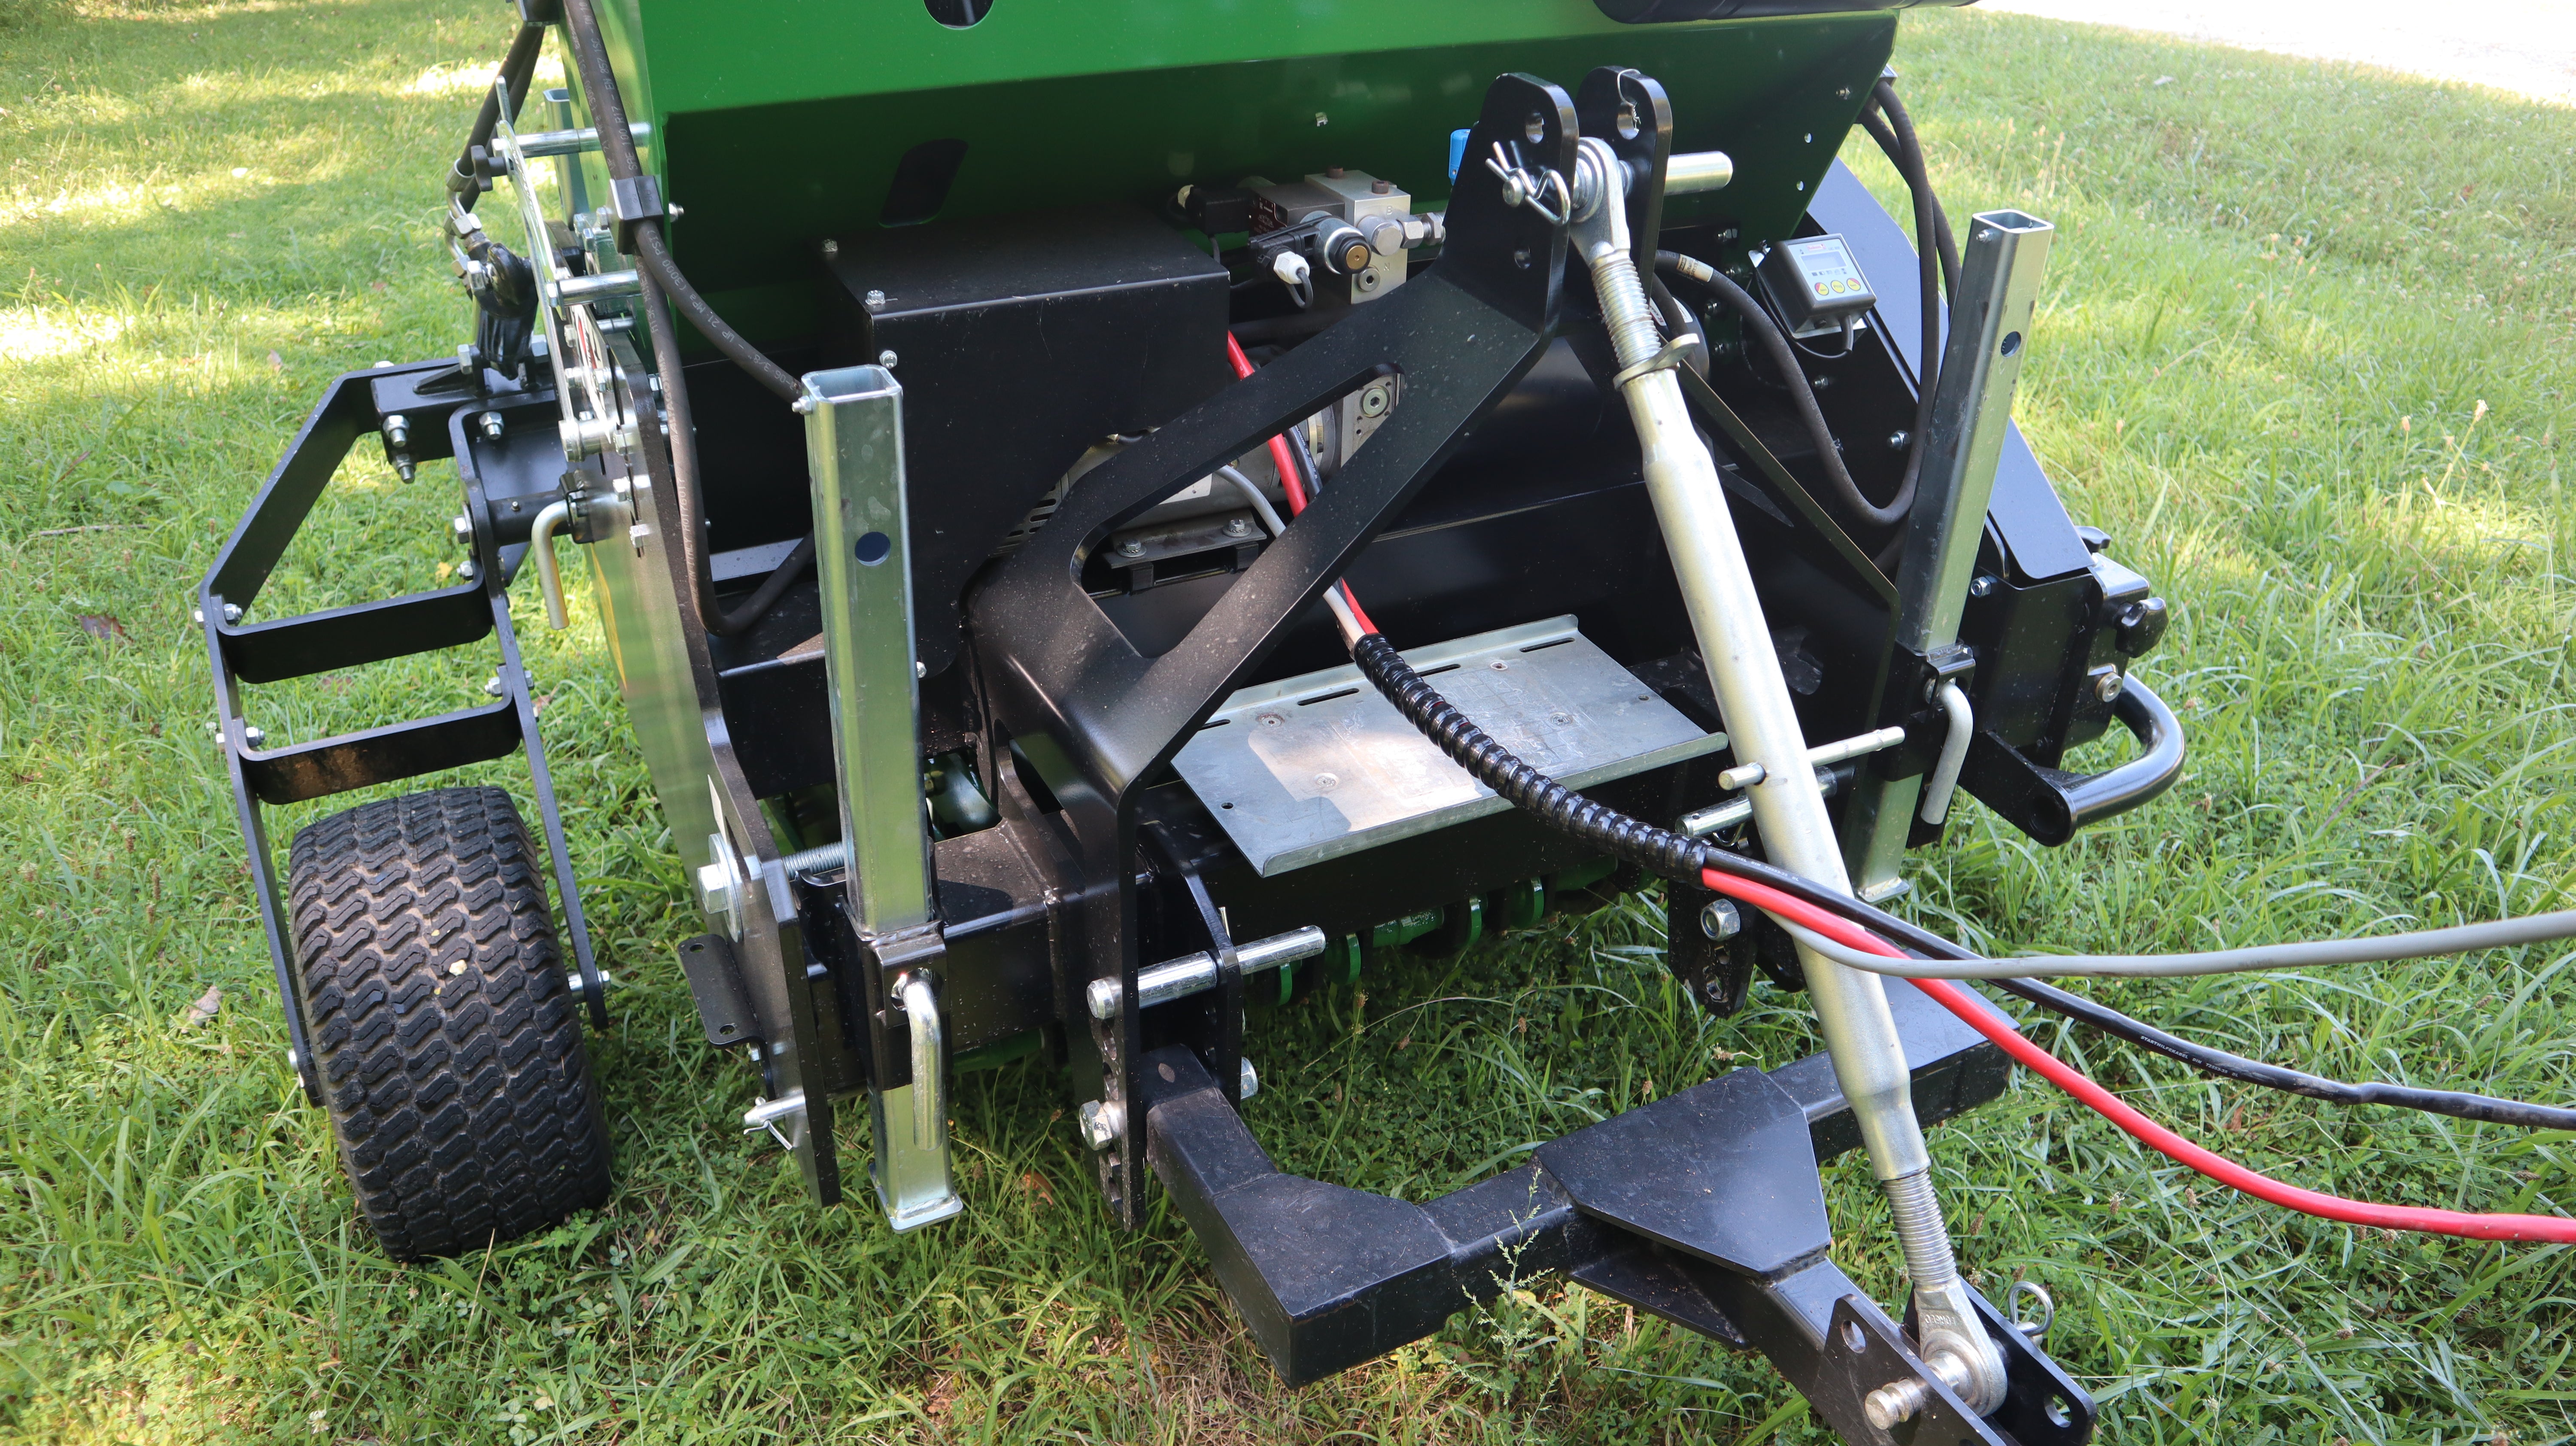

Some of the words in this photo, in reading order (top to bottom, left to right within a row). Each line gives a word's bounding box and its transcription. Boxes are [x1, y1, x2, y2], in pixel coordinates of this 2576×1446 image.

[597, 58, 609, 73] 857
[603, 79, 615, 90] EN
[611, 106, 625, 124] R17
[619, 129, 630, 146] 100
[626, 152, 638, 170] SAE
[647, 230, 665, 256] PSI)
[662, 259, 687, 290] (3000
[659, 350, 678, 434] ALFAGOMMA
[2140, 1036, 2188, 1059] STARTHILFEKABEL
